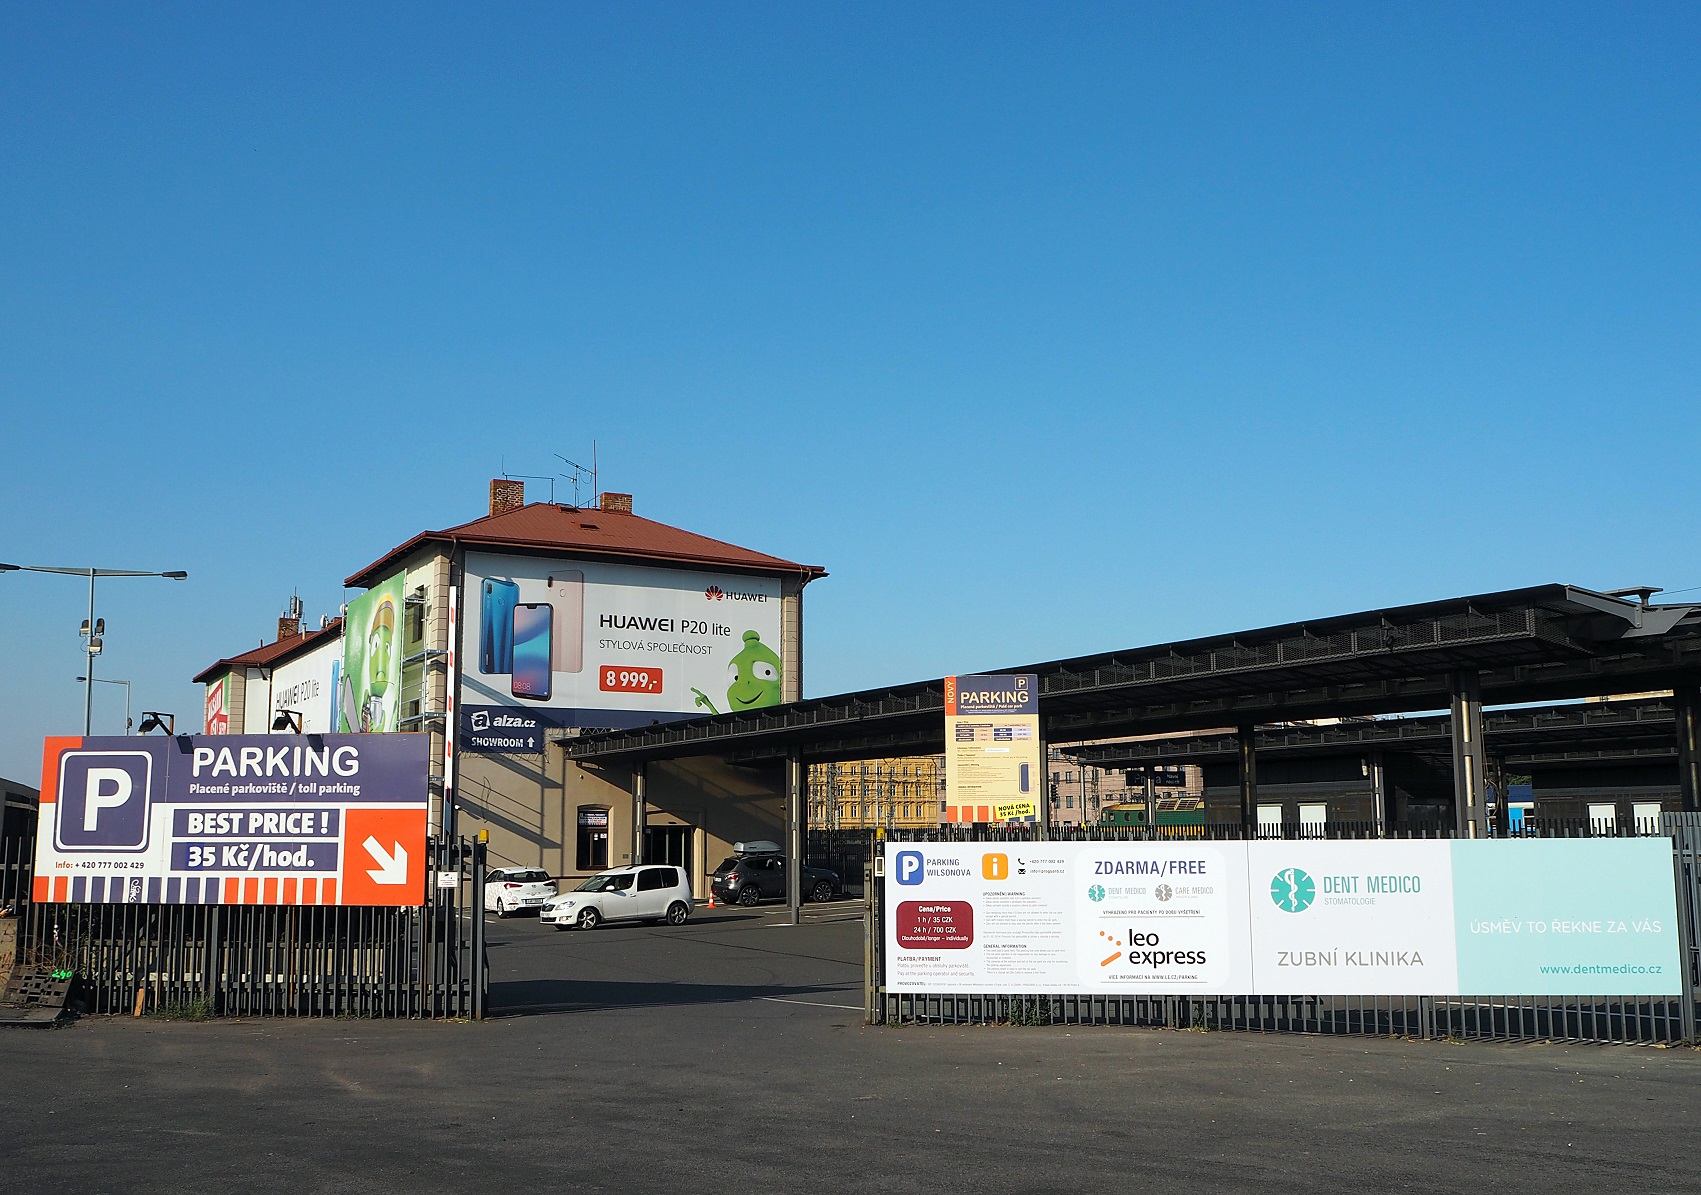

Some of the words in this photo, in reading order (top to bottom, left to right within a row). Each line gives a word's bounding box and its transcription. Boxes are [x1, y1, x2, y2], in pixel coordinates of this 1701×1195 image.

[726, 591, 768, 602] HUAWEI
[600, 614, 674, 632] HUAWEI
[681, 619, 708, 635] P20
[712, 622, 731, 636] lite
[599, 639, 645, 651] STYLOVÁ
[647, 642, 713, 655] SPOLEČNOST
[606, 670, 616, 687] 8
[620, 671, 658, 690] 999,-
[300, 680, 311, 702] P20
[312, 679, 320, 698] lite
[946, 681, 954, 704] NOVÝ
[960, 691, 1029, 704] PARKING
[492, 714, 536, 728] alza.cz
[471, 736, 524, 748] SHOWROOM
[192, 746, 360, 778] PARKING
[189, 783, 230, 794] Placené
[231, 782, 288, 796] parkoviště
[289, 782, 296, 796] /
[298, 783, 316, 794] toll
[318, 784, 361, 796] parking
[84, 768, 133, 832] P
[187, 812, 244, 834] BEST
[248, 812, 315, 834] PRICE
[55, 861, 73, 869] Info:
[188, 846, 216, 867] 35
[222, 844, 315, 871] Kč/hod.
[902, 855, 920, 881] P
[1094, 860, 1206, 878] ZDARMA/FREE
[1108, 887, 1122, 895] DENT
[1125, 887, 1146, 895] MEDICO
[1175, 886, 1190, 894] CARE
[1192, 886, 1214, 894] MEDICO
[1323, 876, 1359, 894] DENT
[1367, 875, 1421, 894] MEDICO
[1324, 897, 1376, 906] STOMATOLOGIE
[1470, 919, 1522, 933] ÚSMĚV
[1526, 921, 1547, 933] TO
[1552, 918, 1602, 933] ŘEKNE
[1607, 921, 1628, 933] ZA
[1632, 918, 1662, 933] VÁS
[1128, 928, 1160, 947] leo
[1128, 951, 1206, 969] express
[1277, 947, 1338, 966] ZUBNÍ
[1345, 951, 1424, 966] KLINIKA
[1539, 963, 1662, 974] www.dentmedico.cz
